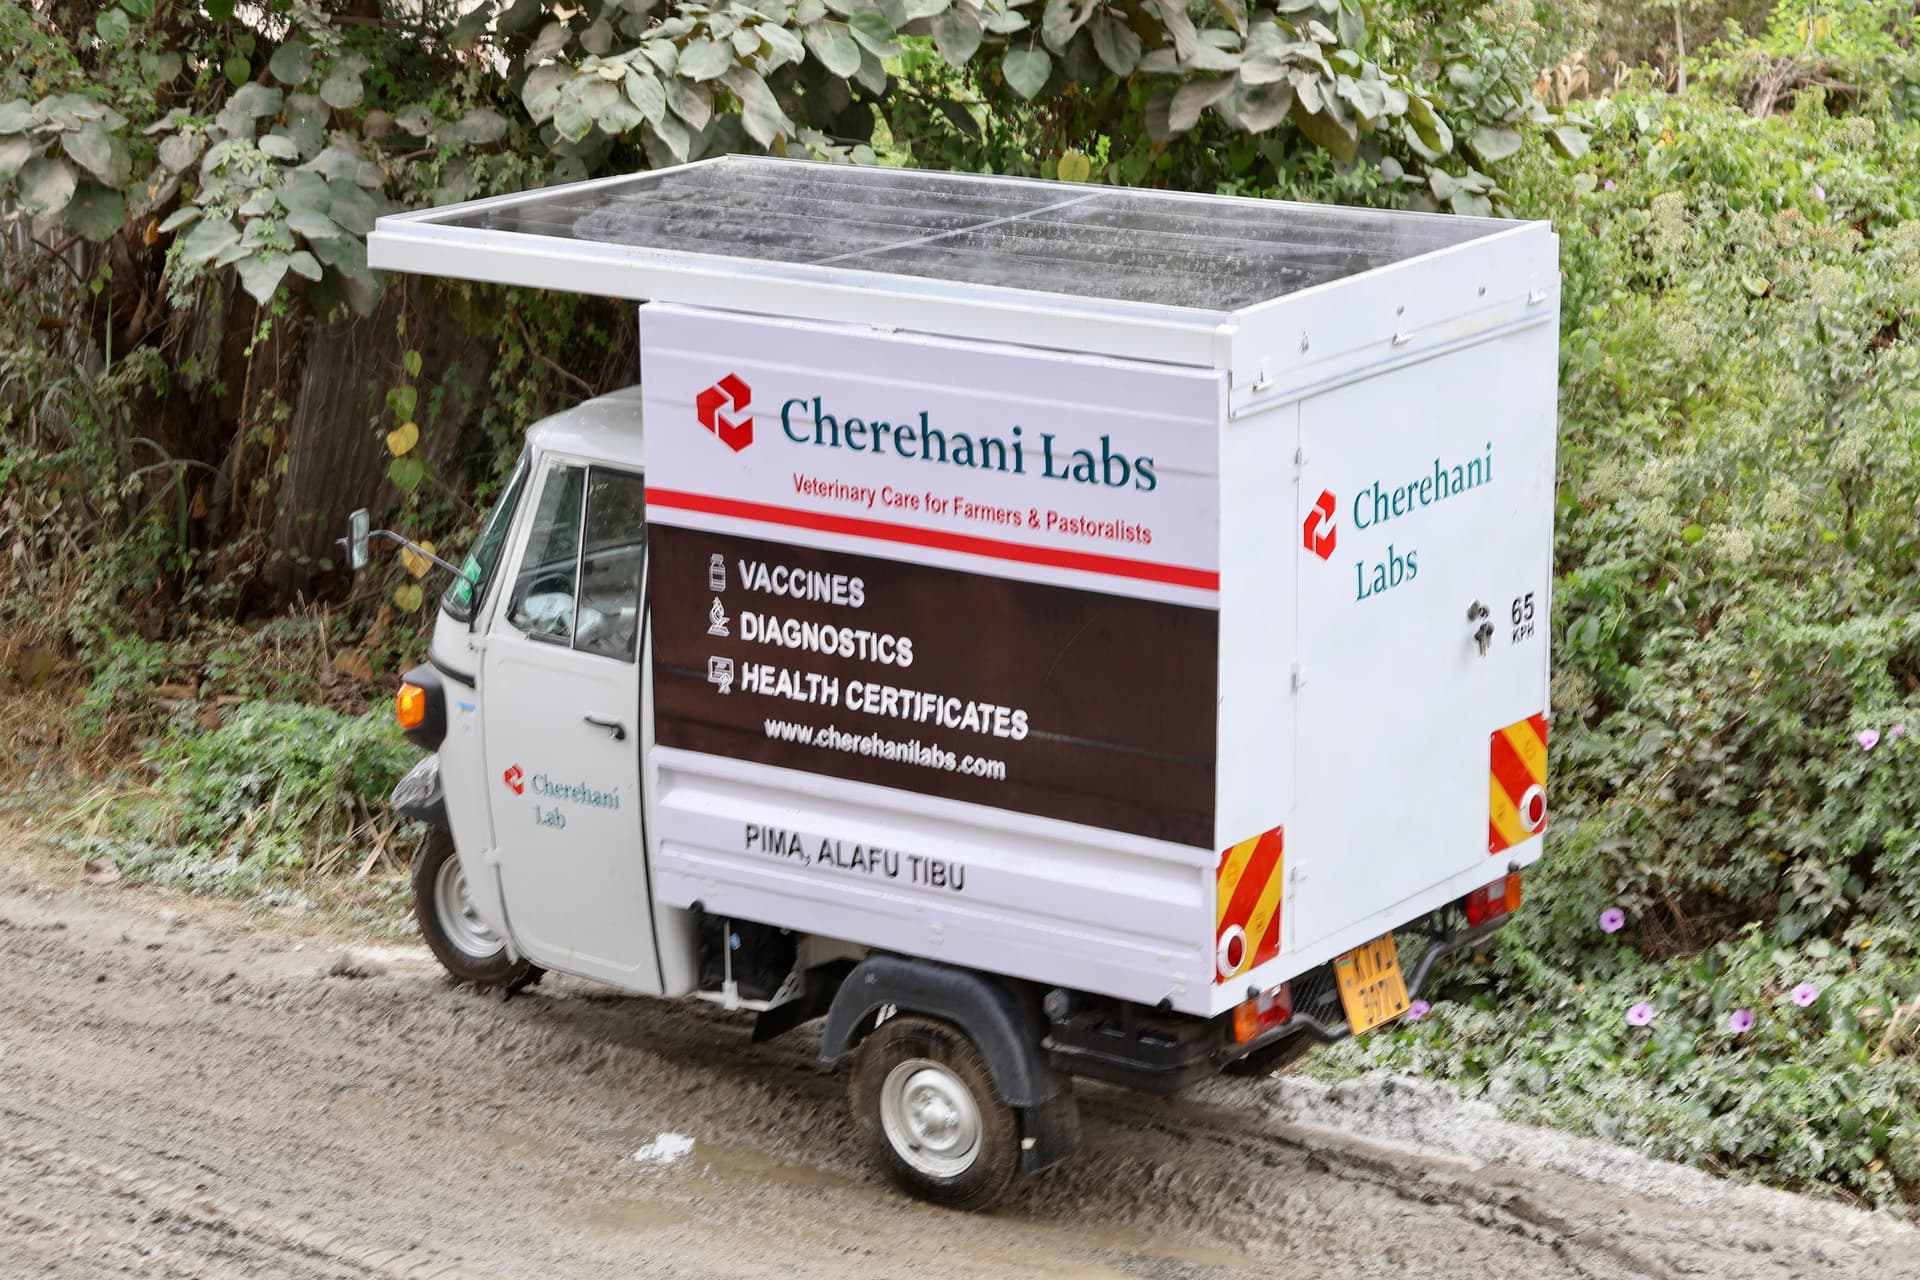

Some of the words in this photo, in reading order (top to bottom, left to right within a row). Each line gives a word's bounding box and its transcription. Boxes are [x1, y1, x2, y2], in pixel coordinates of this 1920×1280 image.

[781, 396, 1025, 474] Cherehani
[1040, 432, 1158, 493] Labs
[793, 473, 876, 508] Veterinary
[881, 484, 920, 510] Care
[925, 491, 949, 515] for
[953, 496, 1022, 527] Farmers
[1028, 508, 1040, 529] &
[1046, 511, 1152, 544] Pastoralists
[1353, 441, 1492, 530] Cherehani
[738, 559, 866, 608] VACCINES
[1354, 543, 1418, 603] Labs
[1511, 592, 1534, 625] 65
[1511, 621, 1534, 644] KPH
[740, 611, 913, 668] DIAGNOSTICS
[741, 662, 839, 706] HEALTH
[845, 680, 1029, 741] CERTIFICATES
[764, 718, 1007, 781] www.cherehanilabs.com
[531, 773, 619, 809] Cherehani
[535, 805, 566, 830] Lab
[745, 823, 811, 867] PIMA,
[818, 837, 900, 878] ALAFU
[908, 855, 967, 892] TIBU
